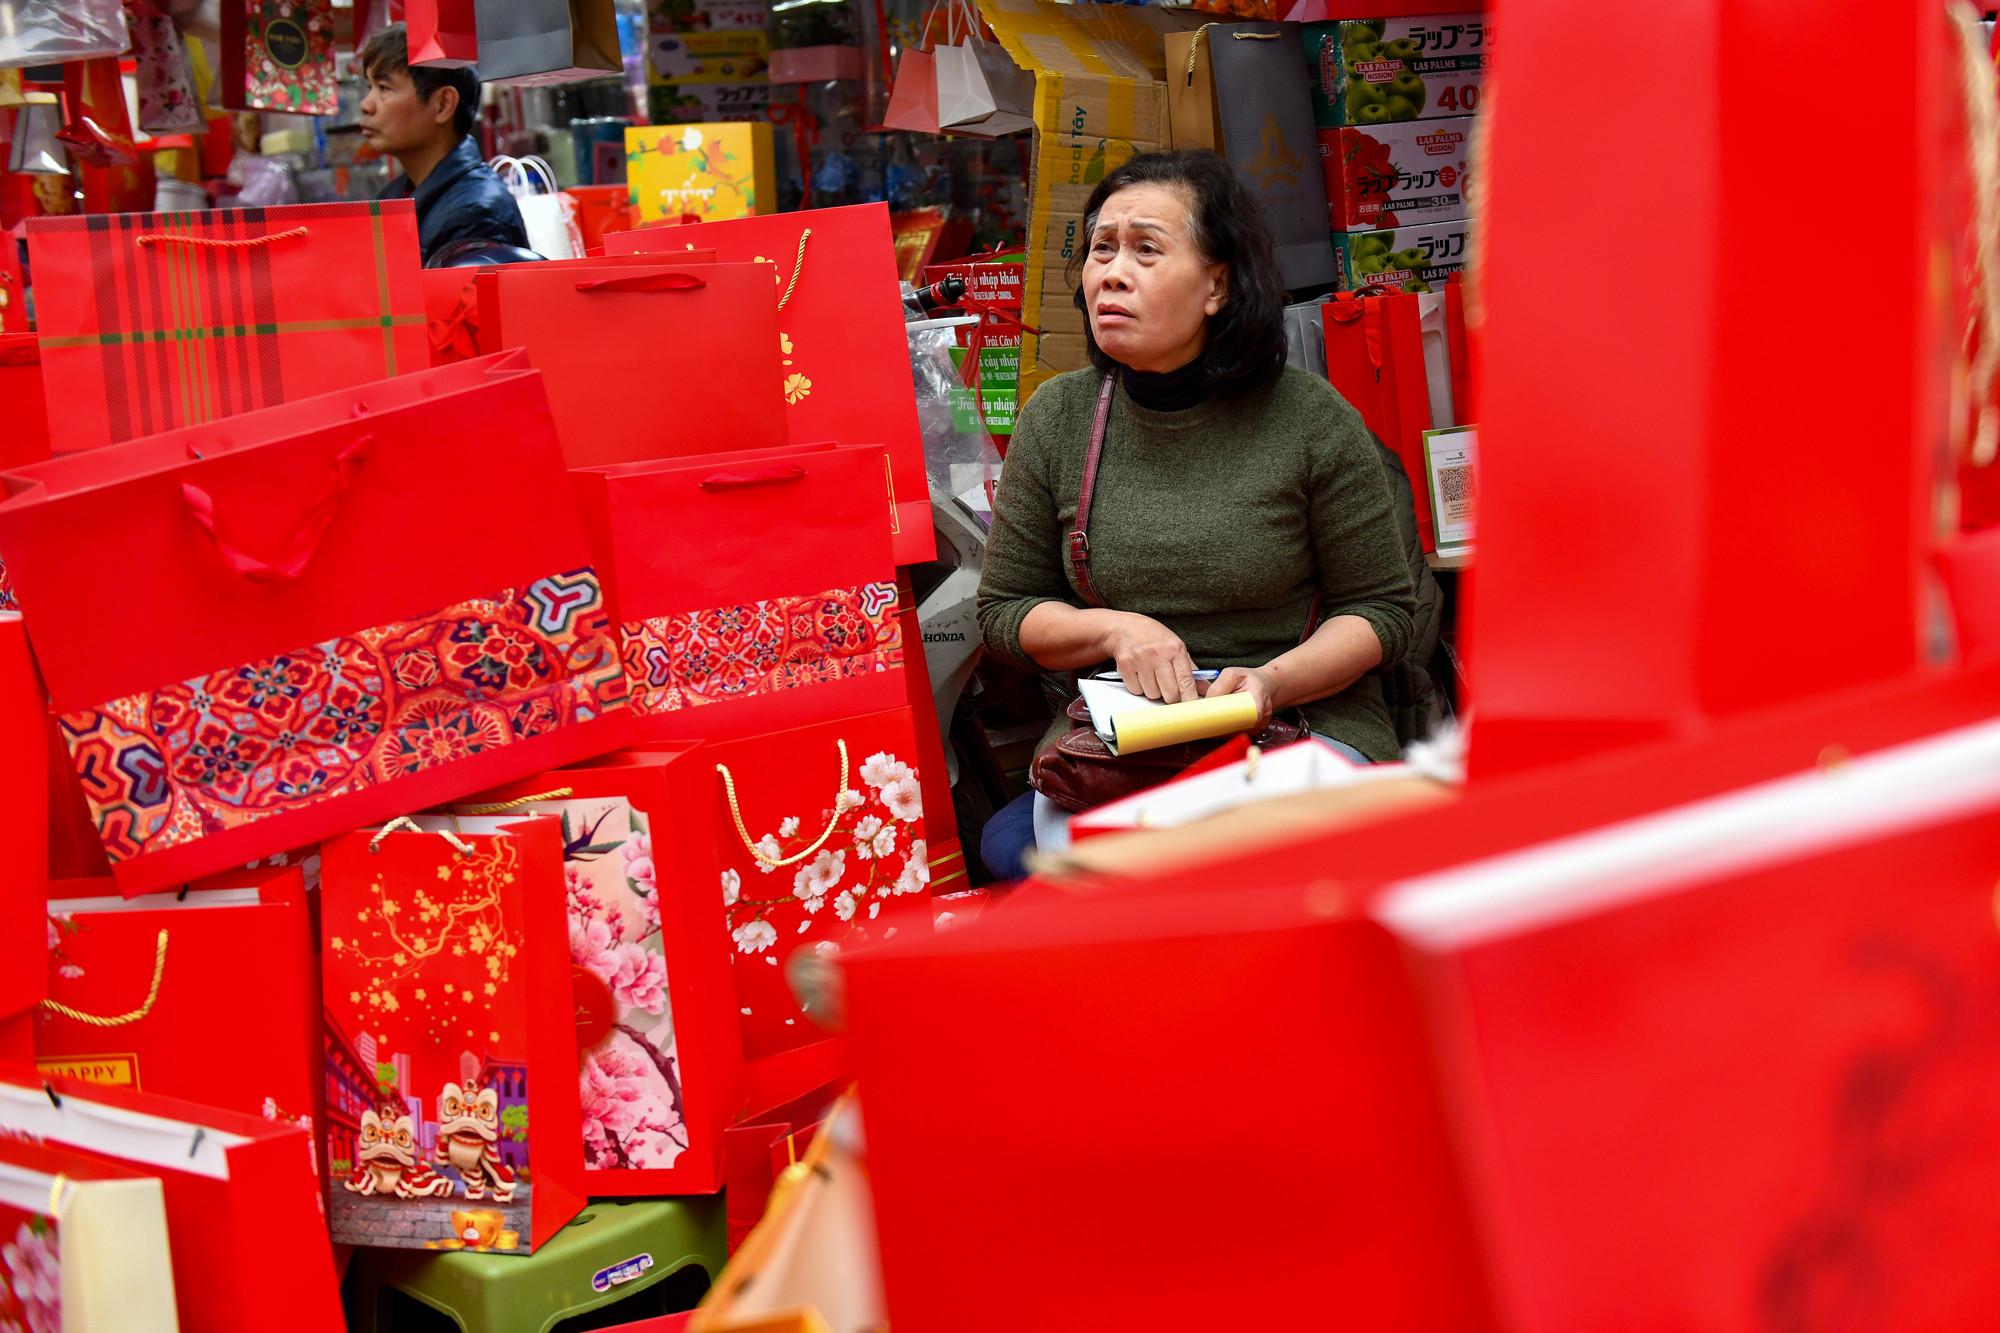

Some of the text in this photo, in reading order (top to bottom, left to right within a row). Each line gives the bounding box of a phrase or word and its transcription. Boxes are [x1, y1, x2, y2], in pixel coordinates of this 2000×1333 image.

[1358, 61, 1401, 72] LAS PALMS
[1413, 61, 1429, 71] LAS
[1430, 60, 1456, 70] PALMS
[1366, 71, 1393, 80] MISSION
[1072, 105, 1087, 139] Tây
[1419, 133, 1461, 145] LAS PALMS
[1428, 143, 1453, 152] MISSION
[1067, 144, 1083, 185] hoai
[660, 173, 715, 214] TẾT
[1384, 202, 1395, 210] LAS
[1396, 201, 1415, 209] PALMS
[980, 272, 998, 289] nhập
[999, 268, 1020, 285] khẩu
[1369, 272, 1410, 284] LAS PALMS
[1422, 270, 1437, 280] LAS
[984, 335, 998, 348] Trái
[999, 334, 1013, 348] Cây
[984, 355, 999, 370] cây
[981, 398, 992, 414] ây
[993, 397, 1014, 415] nhập
[923, 632, 966, 643] HONDA
